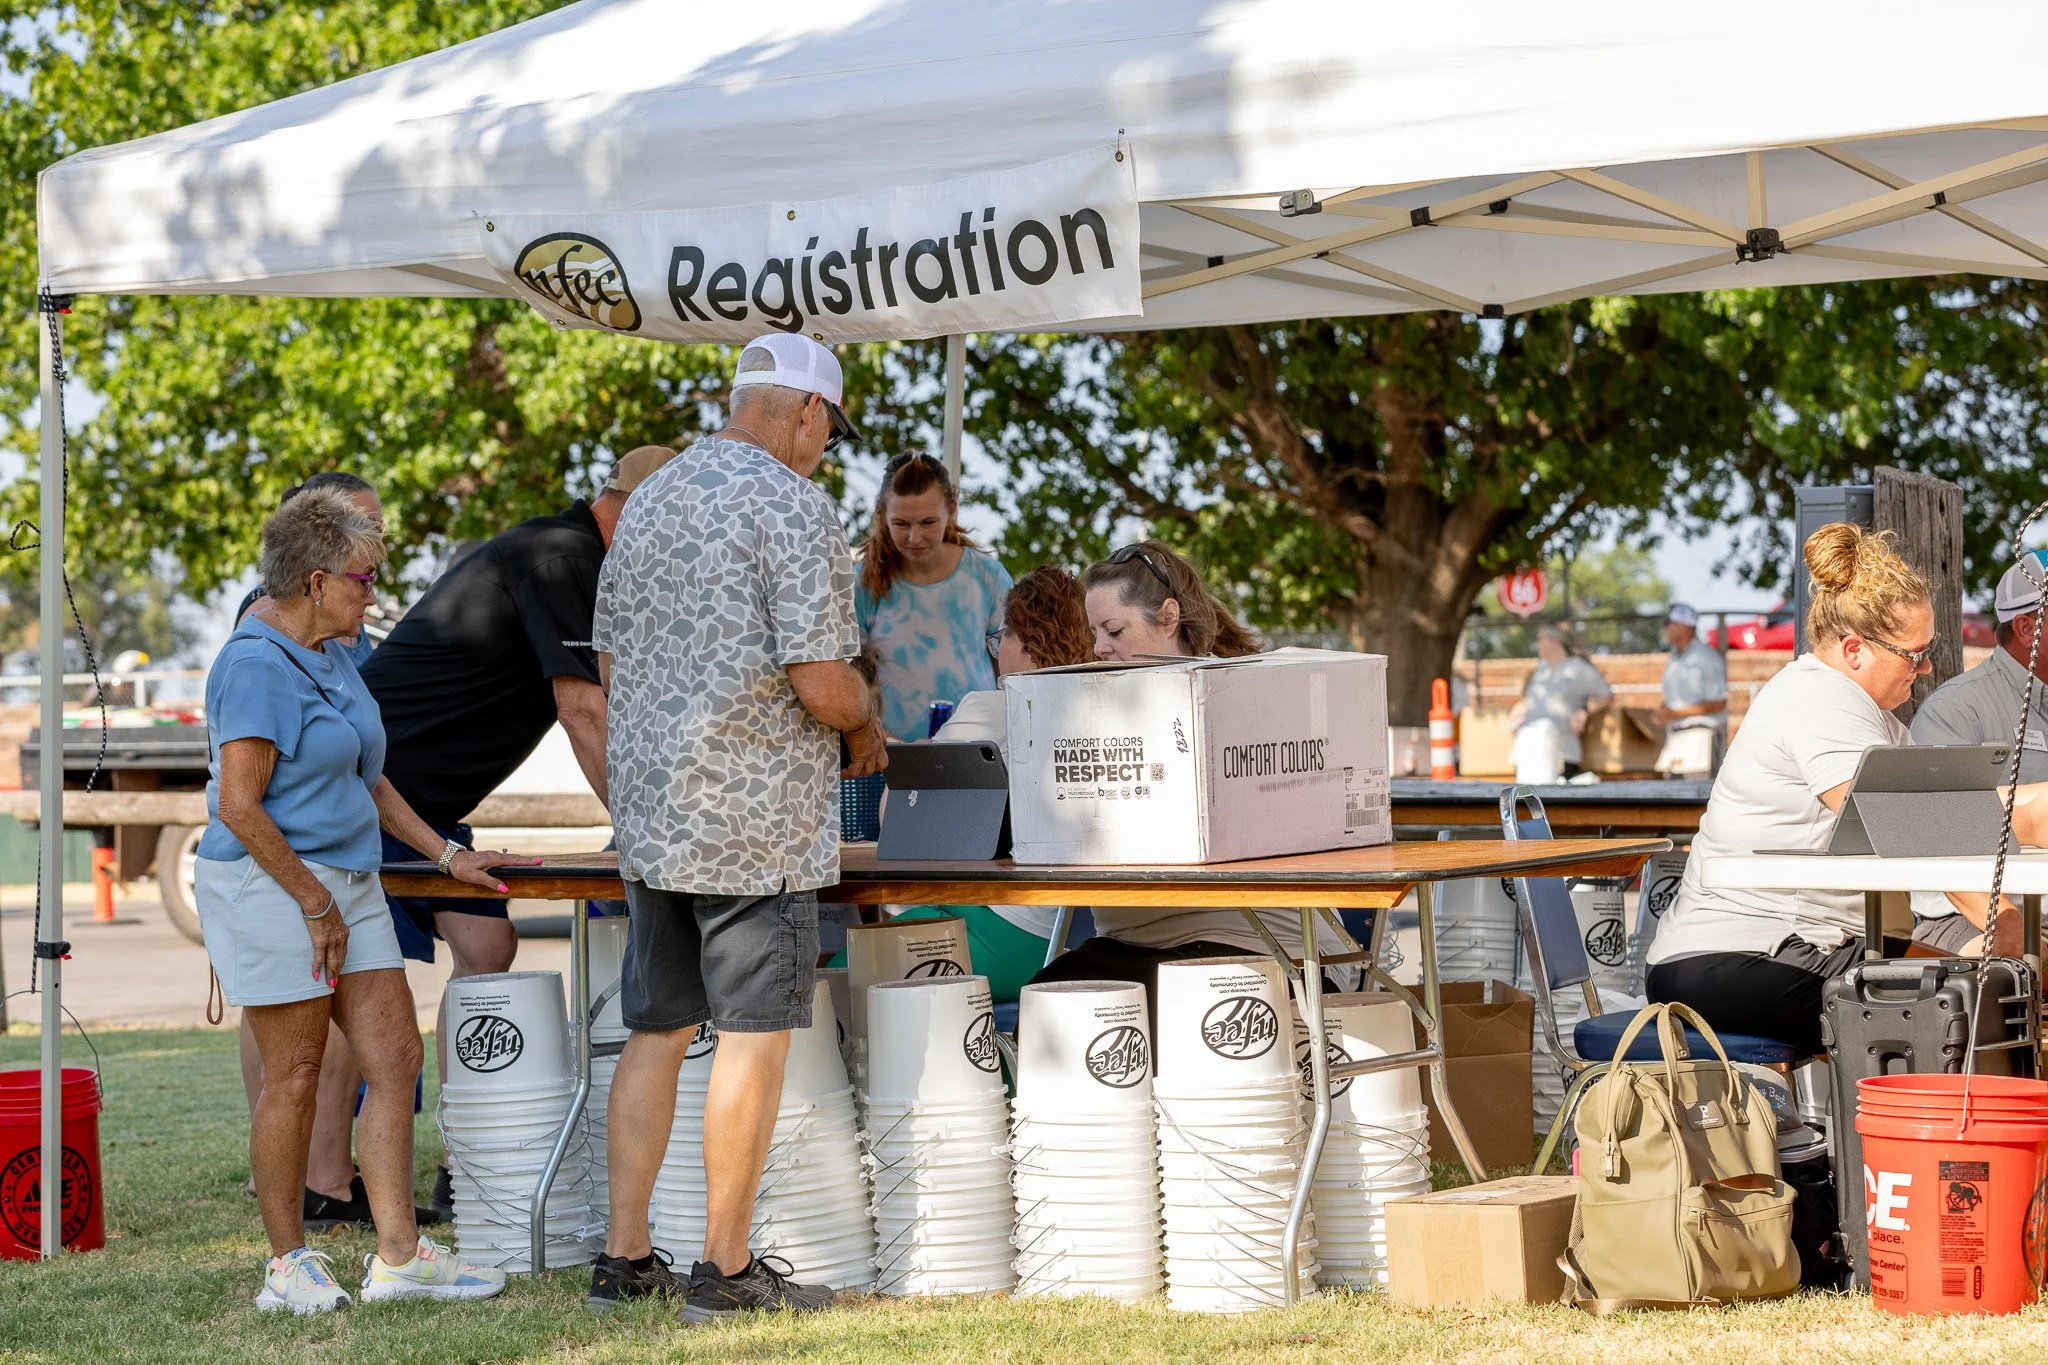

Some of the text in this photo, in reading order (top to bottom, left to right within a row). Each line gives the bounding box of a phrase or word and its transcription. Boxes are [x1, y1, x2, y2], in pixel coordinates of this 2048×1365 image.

[522, 206, 1114, 333] nfec Registration
[1053, 737, 1143, 748] COMFORT COLORS
[1054, 748, 1144, 763] MADE WITH
[1224, 743, 1277, 779] COMFORT
[1210, 1003, 1274, 1054] nfec
[459, 1021, 519, 1068] nfec
[1873, 1230, 1905, 1245] place.
[1879, 1260, 1905, 1272] Center
